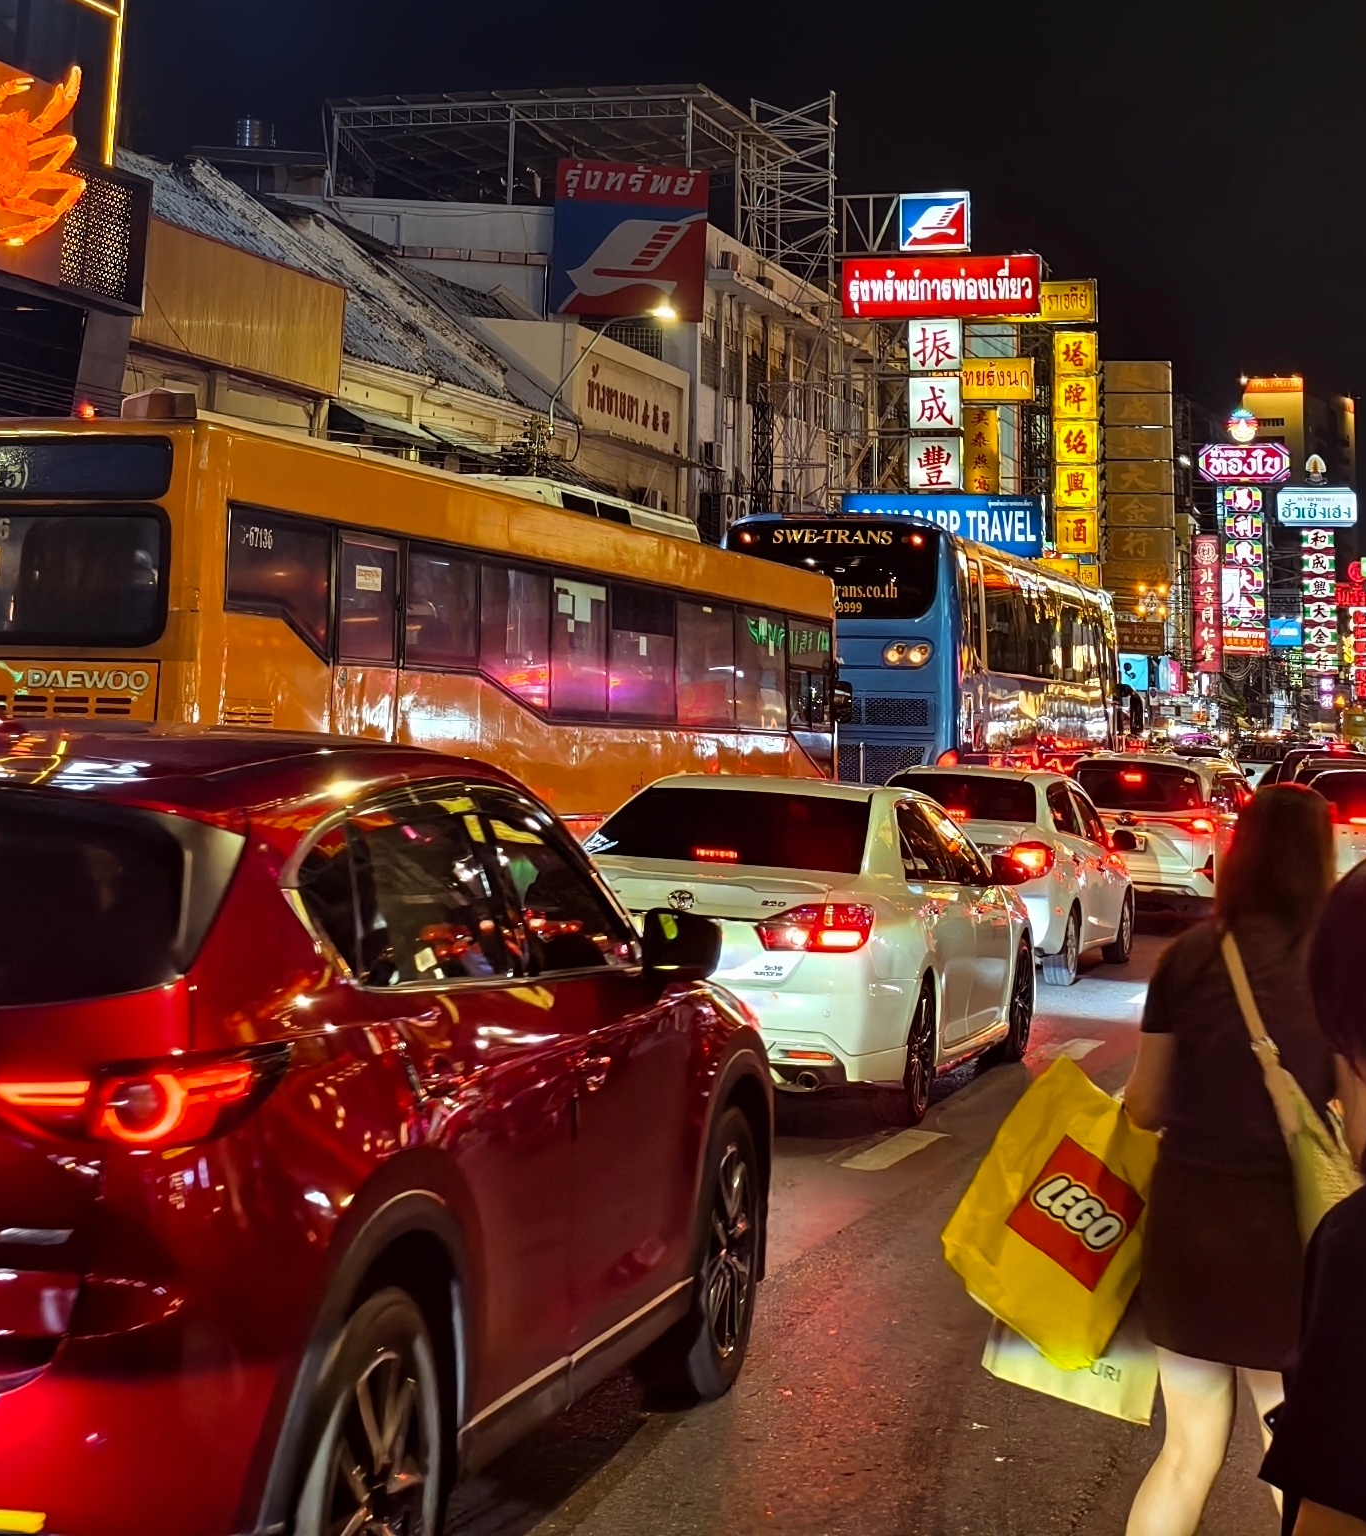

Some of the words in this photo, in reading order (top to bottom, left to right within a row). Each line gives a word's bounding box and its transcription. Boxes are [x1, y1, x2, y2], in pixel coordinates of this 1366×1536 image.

[564, 161, 702, 200] รุ่งทรัพย์
[849, 259, 1034, 314] รุ่งทรัพย์การท่องเที่ยว
[963, 363, 1031, 389] ทยรังนก
[912, 326, 958, 488] 振成豐
[772, 529, 894, 546] SWE-TRANS
[966, 510, 1037, 543] TRAVEL
[27, 667, 151, 693] DAEWOO
[1032, 1174, 1126, 1252] LEGO
